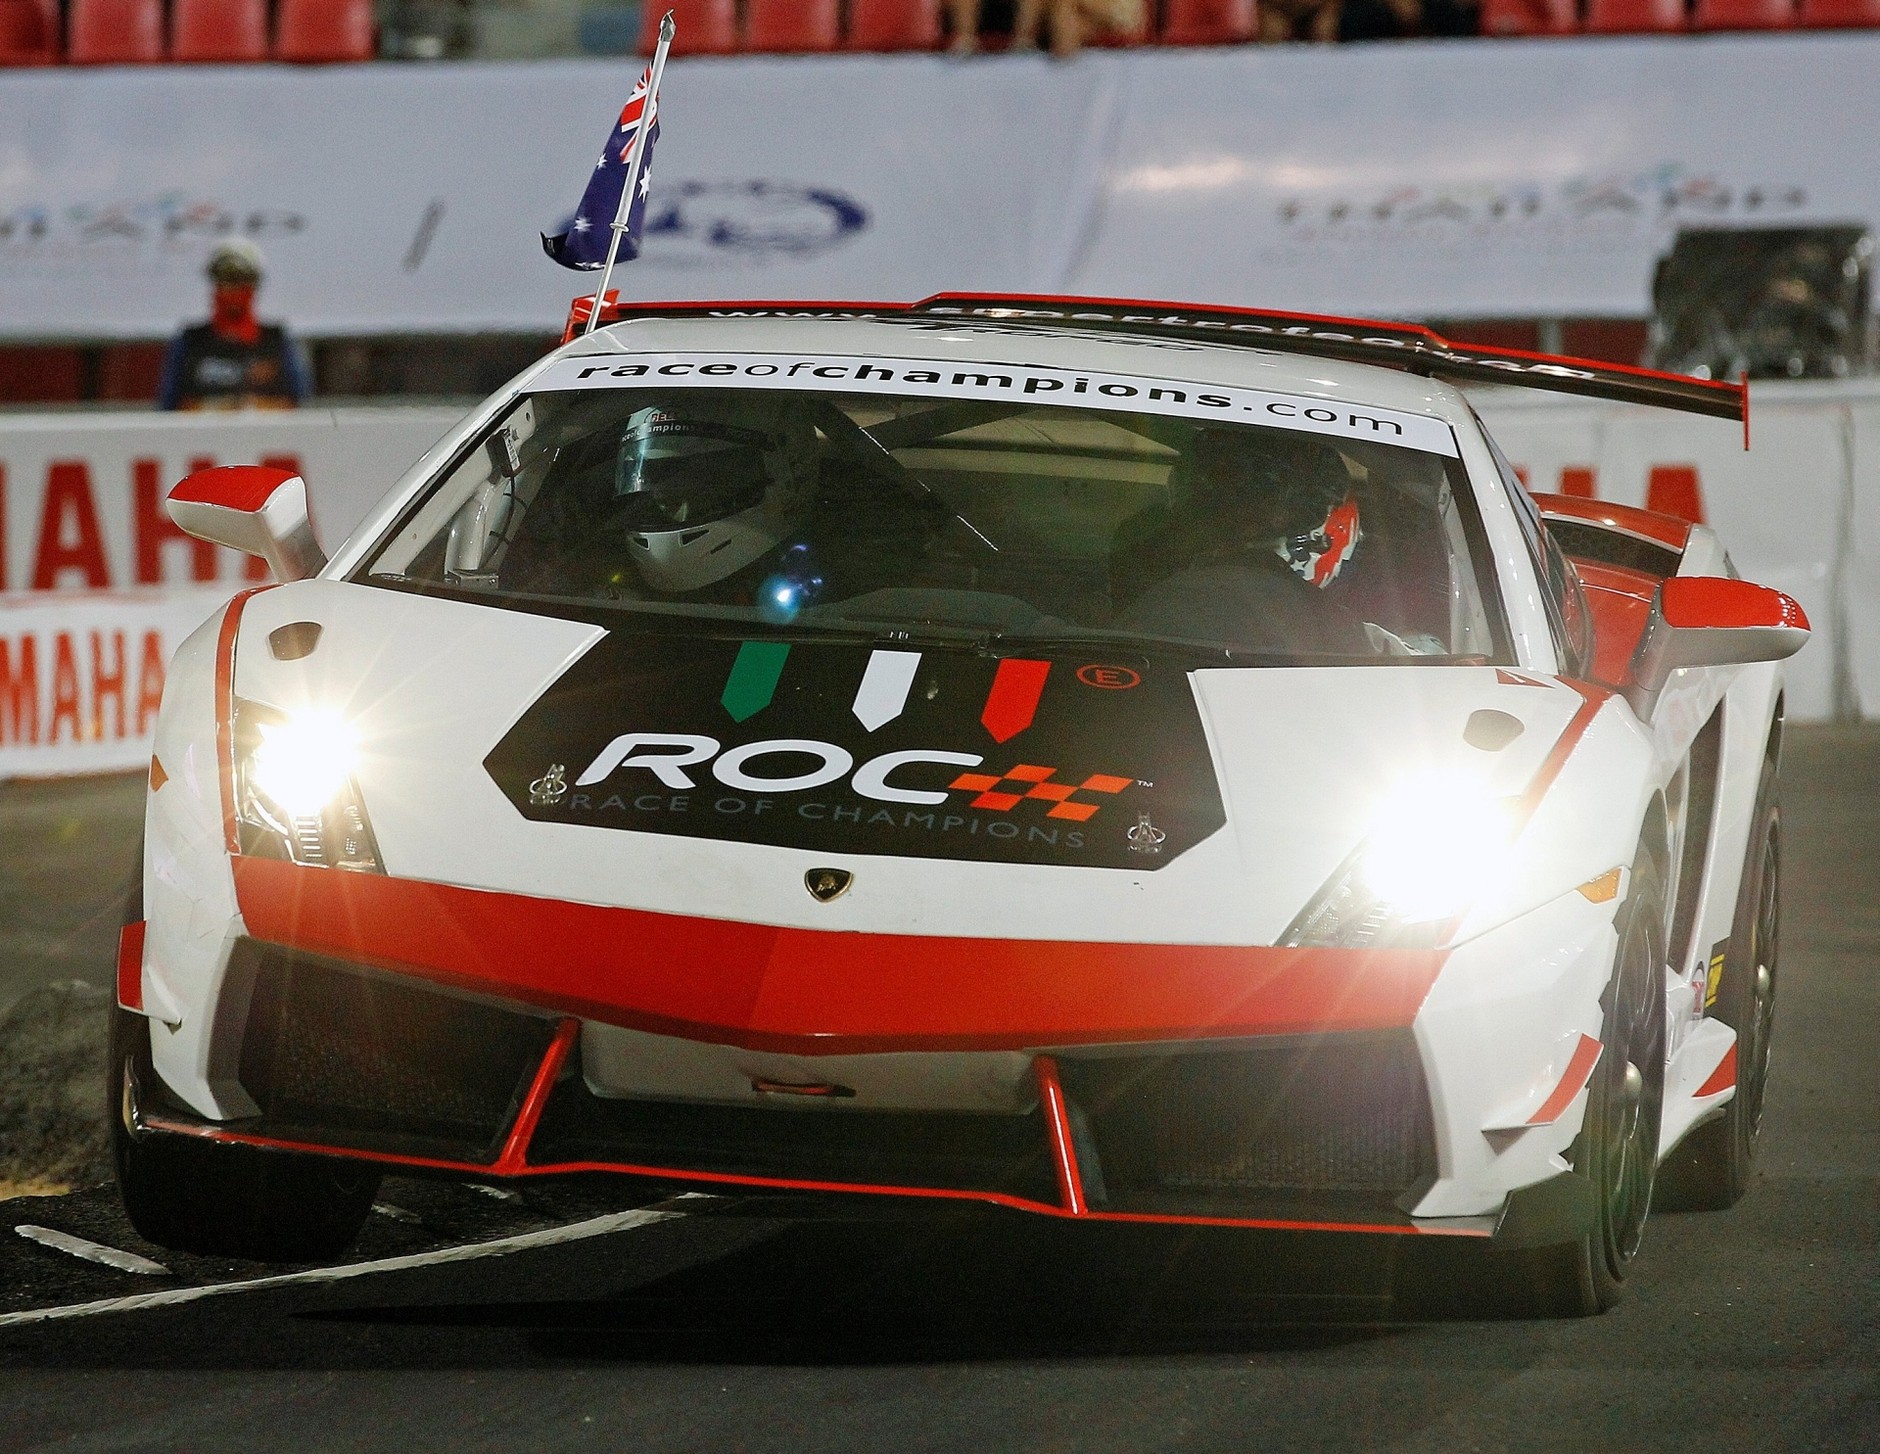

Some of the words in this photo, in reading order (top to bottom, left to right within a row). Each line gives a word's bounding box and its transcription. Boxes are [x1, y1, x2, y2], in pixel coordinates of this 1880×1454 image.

[576, 361, 1403, 436] raceofchampions.com
[575, 732, 984, 805] ROC
[570, 794, 690, 812] RACE
[714, 798, 773, 815] OF
[798, 803, 1085, 849] CHAMPIONS
